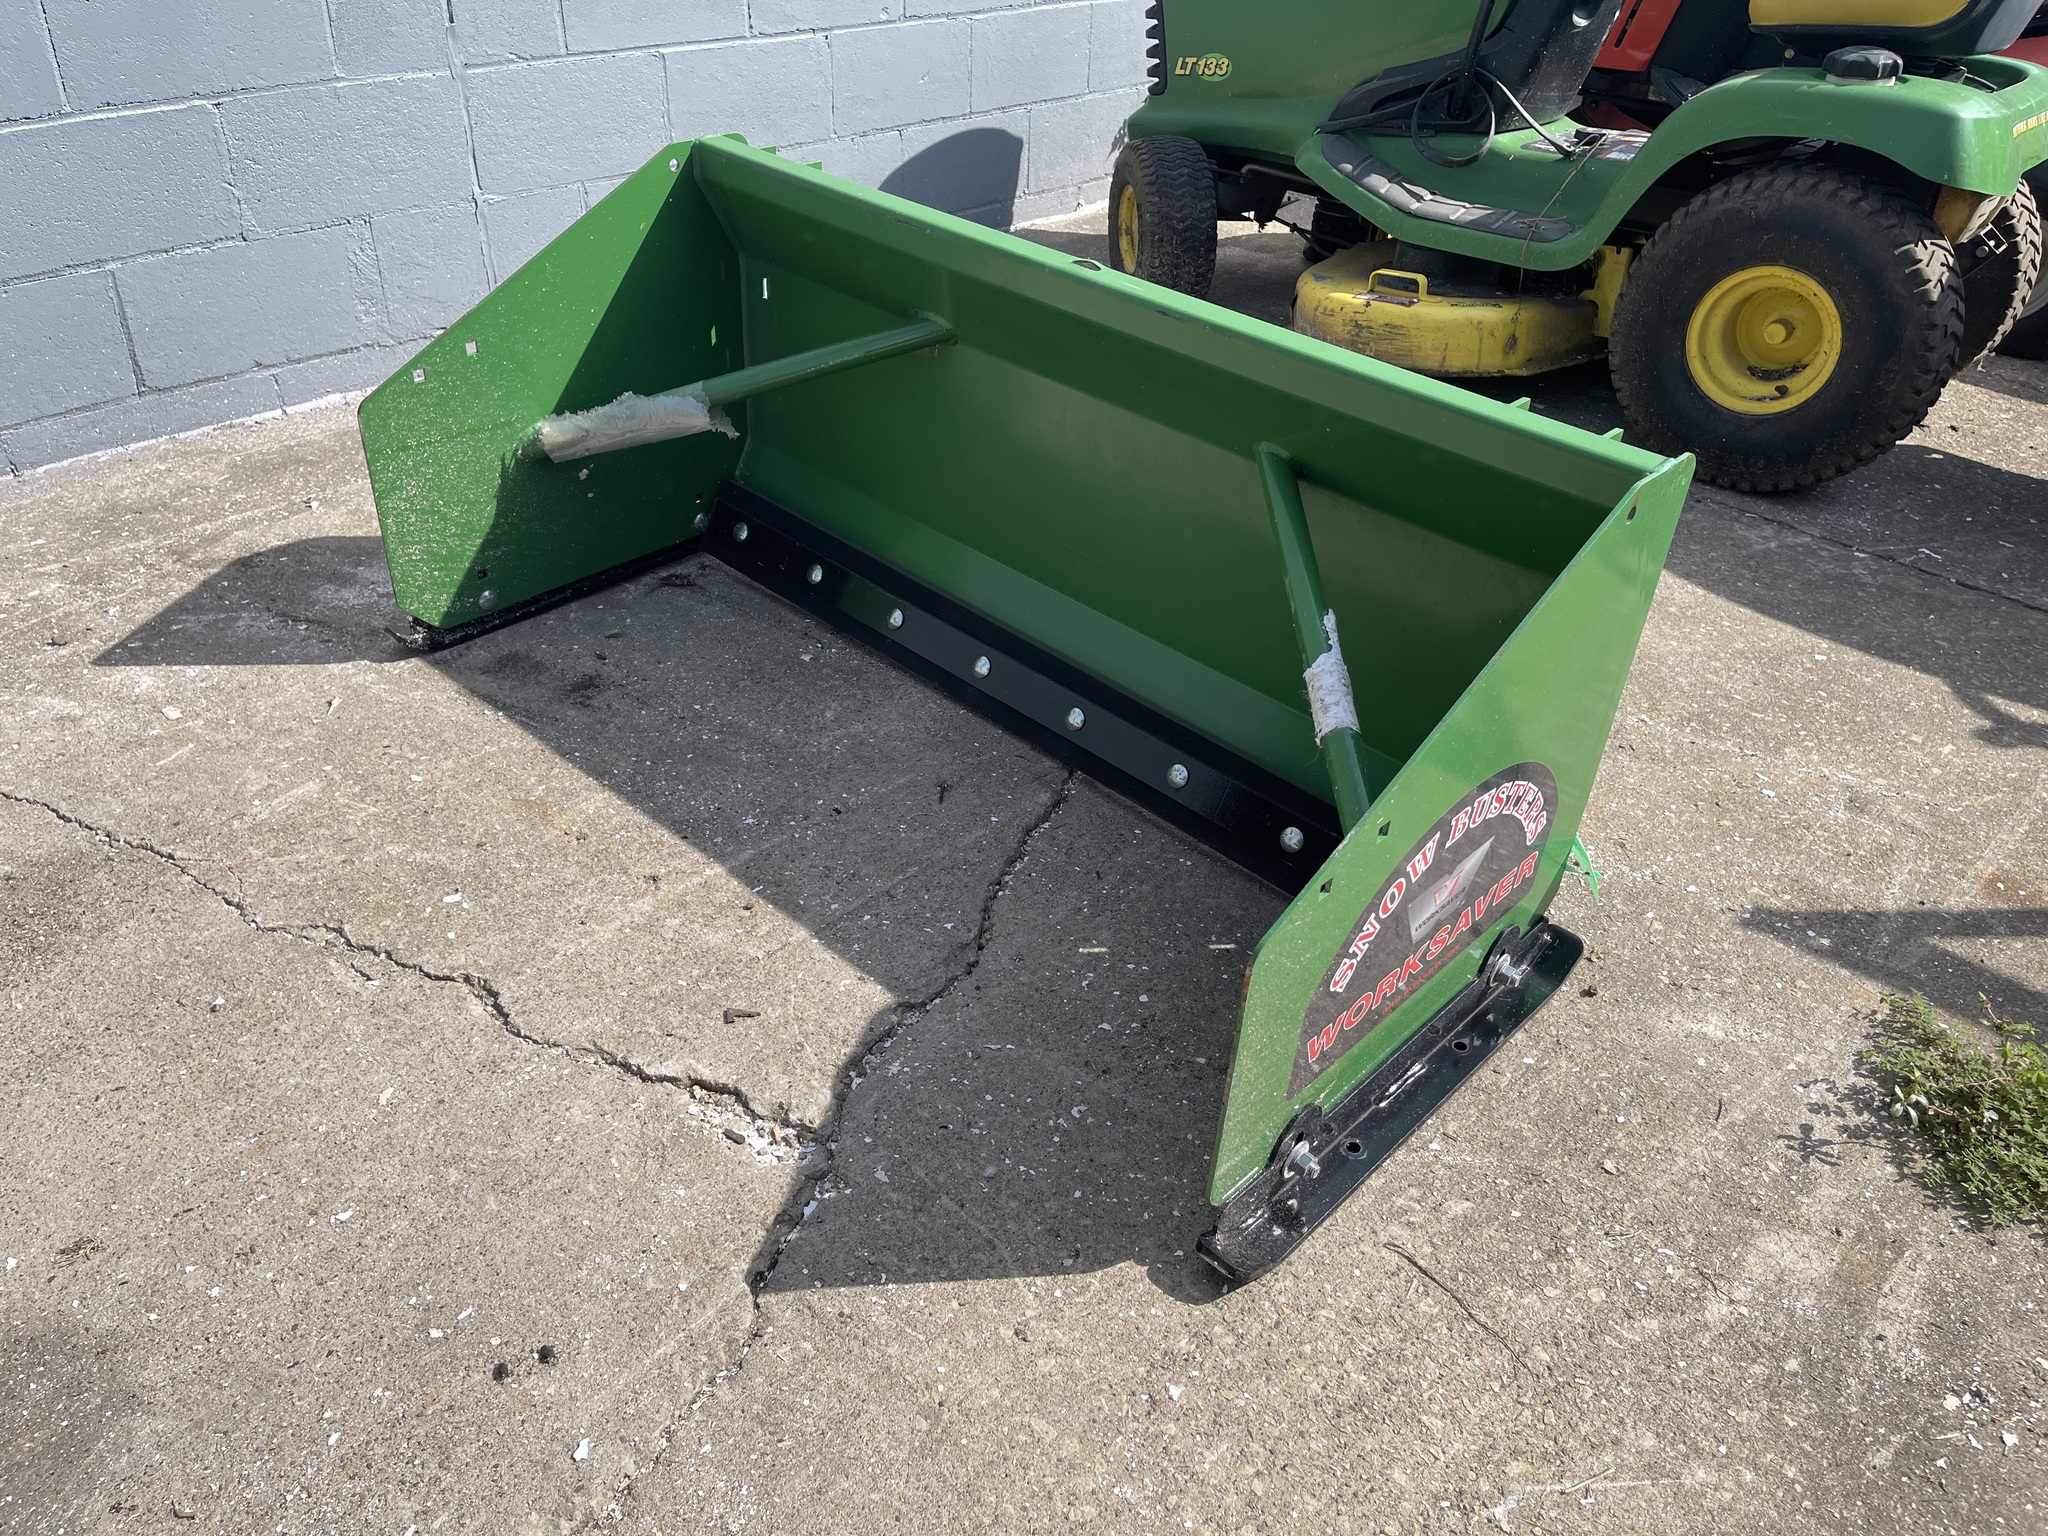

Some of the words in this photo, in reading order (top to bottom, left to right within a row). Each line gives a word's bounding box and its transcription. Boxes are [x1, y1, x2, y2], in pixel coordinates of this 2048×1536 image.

[1307, 850, 1539, 1063] WORKSAVER
[1329, 831, 1441, 993] SNOW
[1445, 780, 1547, 849] BUSTERS
